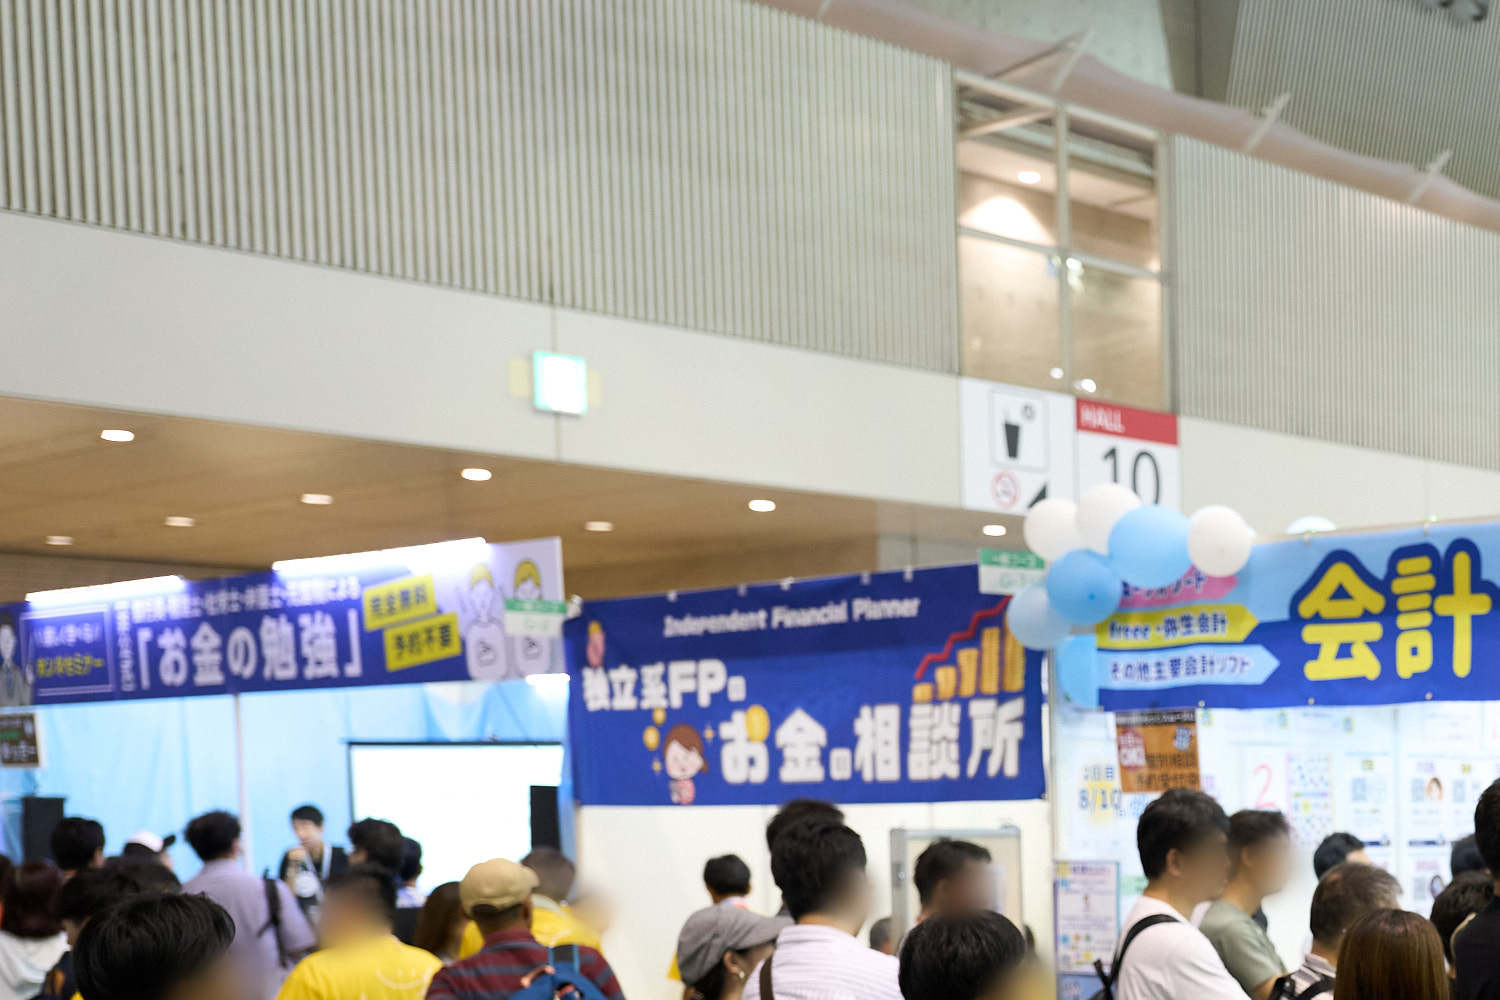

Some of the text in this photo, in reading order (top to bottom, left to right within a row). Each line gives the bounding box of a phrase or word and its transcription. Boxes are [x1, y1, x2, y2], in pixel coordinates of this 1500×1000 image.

[1080, 406, 1126, 433] HALL
[1103, 446, 1161, 506] 10
[663, 597, 921, 638] Independent Financial Planner
[136, 607, 364, 691] 「お金の勉強」
[1110, 653, 1250, 682] その他主要会計ソフト
[718, 697, 1026, 785] お金の相談所
